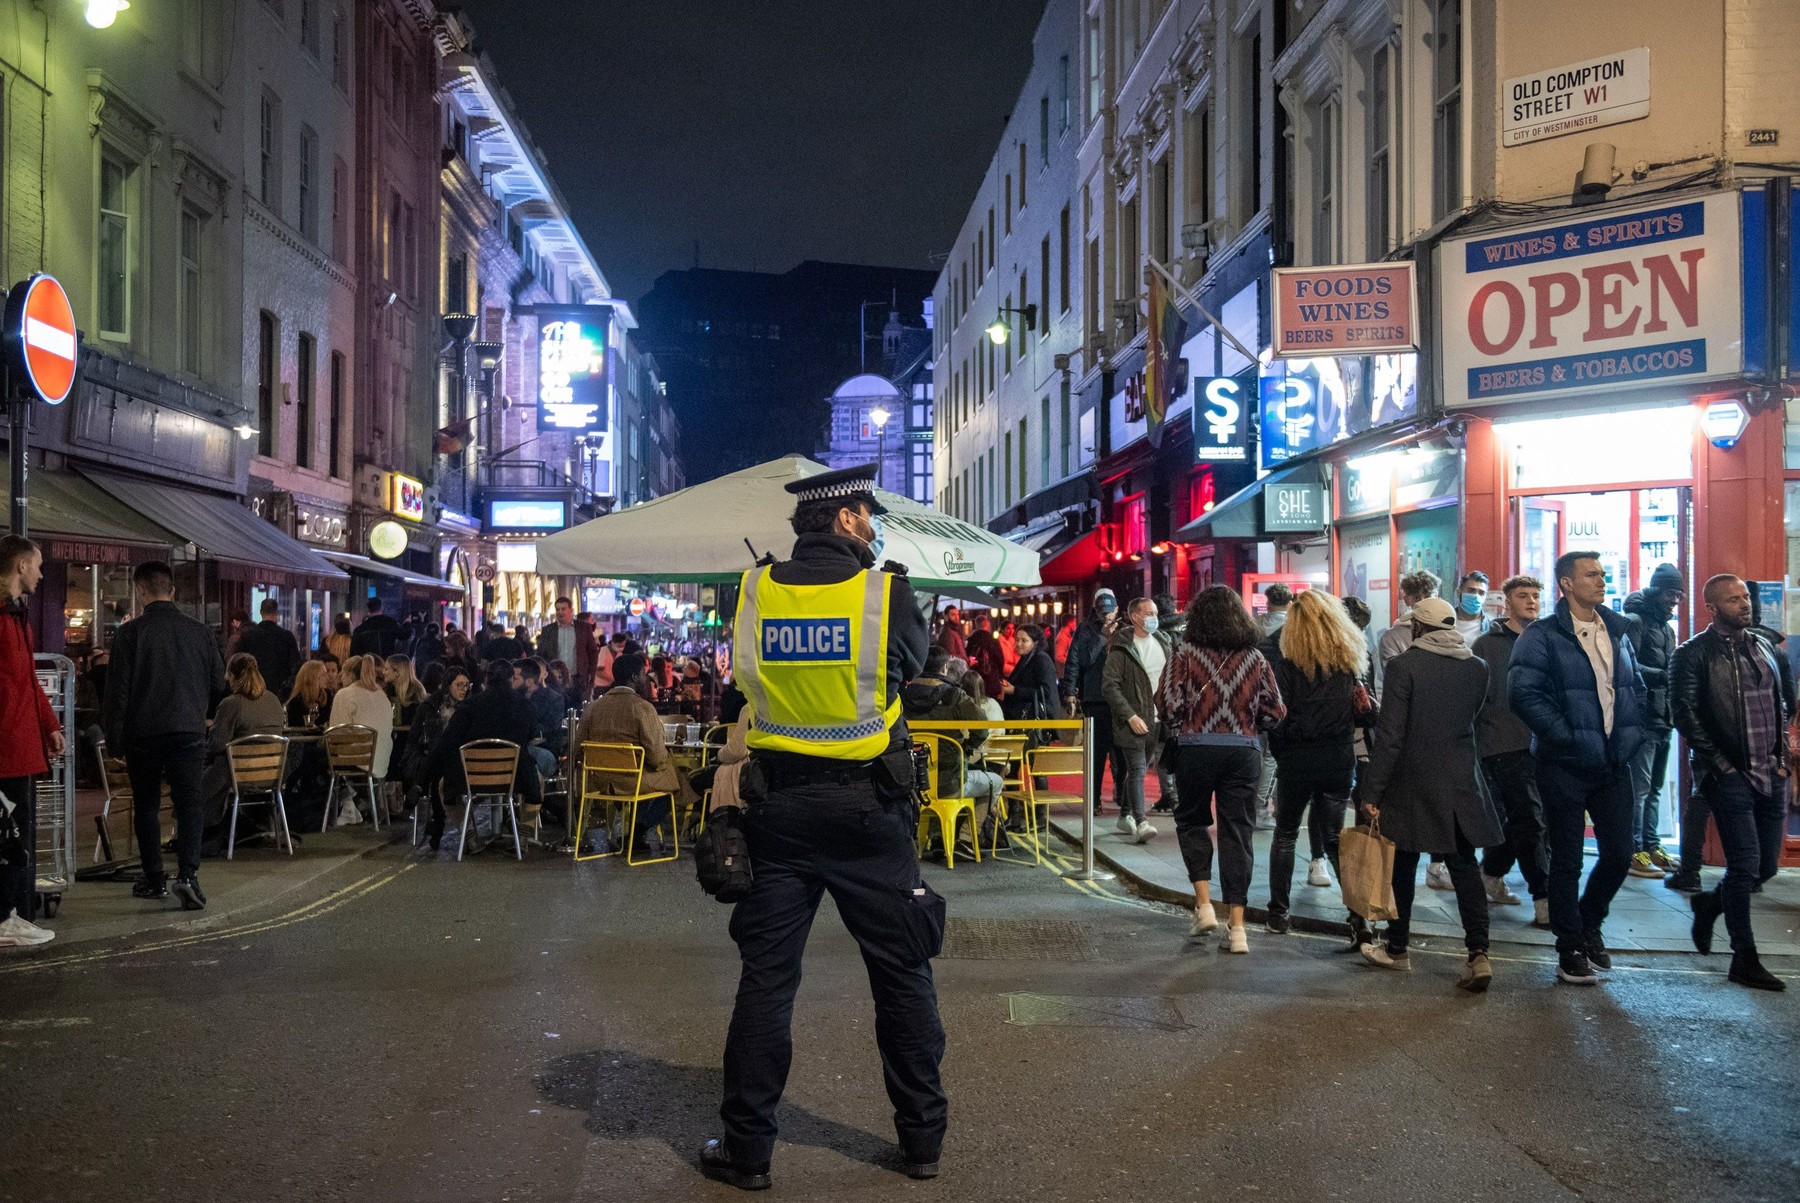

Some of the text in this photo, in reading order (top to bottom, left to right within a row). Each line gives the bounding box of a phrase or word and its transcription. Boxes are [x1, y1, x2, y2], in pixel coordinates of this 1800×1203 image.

[1513, 59, 1624, 100] OLD COMPTON
[1513, 84, 1607, 121] STREET W1
[1513, 115, 1598, 140] CITY OF WESTMINSTER
[1751, 133, 1776, 142] 2441
[1484, 213, 1684, 263] WINES & SPIRITS
[1295, 276, 1392, 298] FOODS
[1299, 301, 1390, 322] WINES
[1467, 247, 1705, 356] OPEN
[1285, 325, 1404, 343] BEERS SPIRITS
[1478, 348, 1693, 391] BEERS & TOBACCOS
[1279, 490, 1310, 515] SHE
[1568, 522, 1599, 536] JUUL
[478, 569, 491, 577] 20
[765, 625, 845, 653] POLICE
